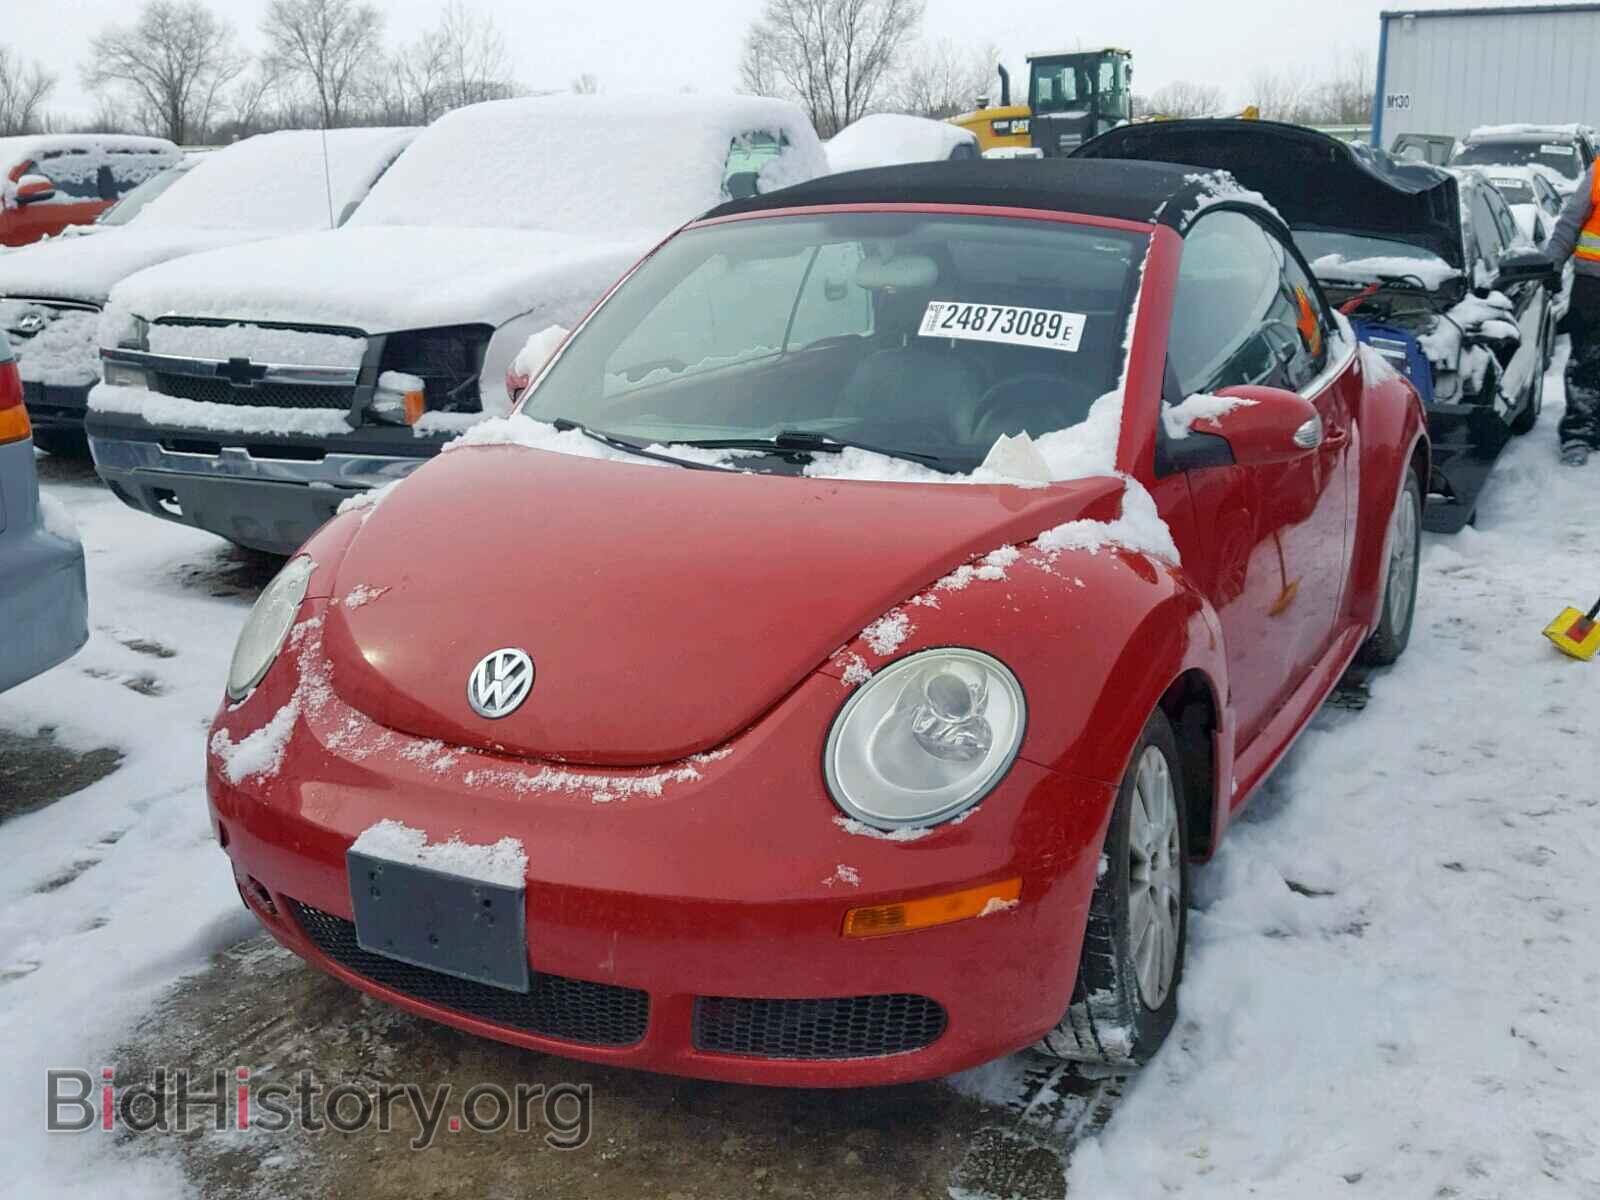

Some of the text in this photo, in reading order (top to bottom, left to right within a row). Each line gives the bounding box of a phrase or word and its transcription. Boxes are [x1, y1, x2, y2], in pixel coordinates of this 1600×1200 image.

[1011, 119, 1030, 133] CAT
[941, 304, 1062, 339] 24873089
[1062, 326, 1073, 341] E
